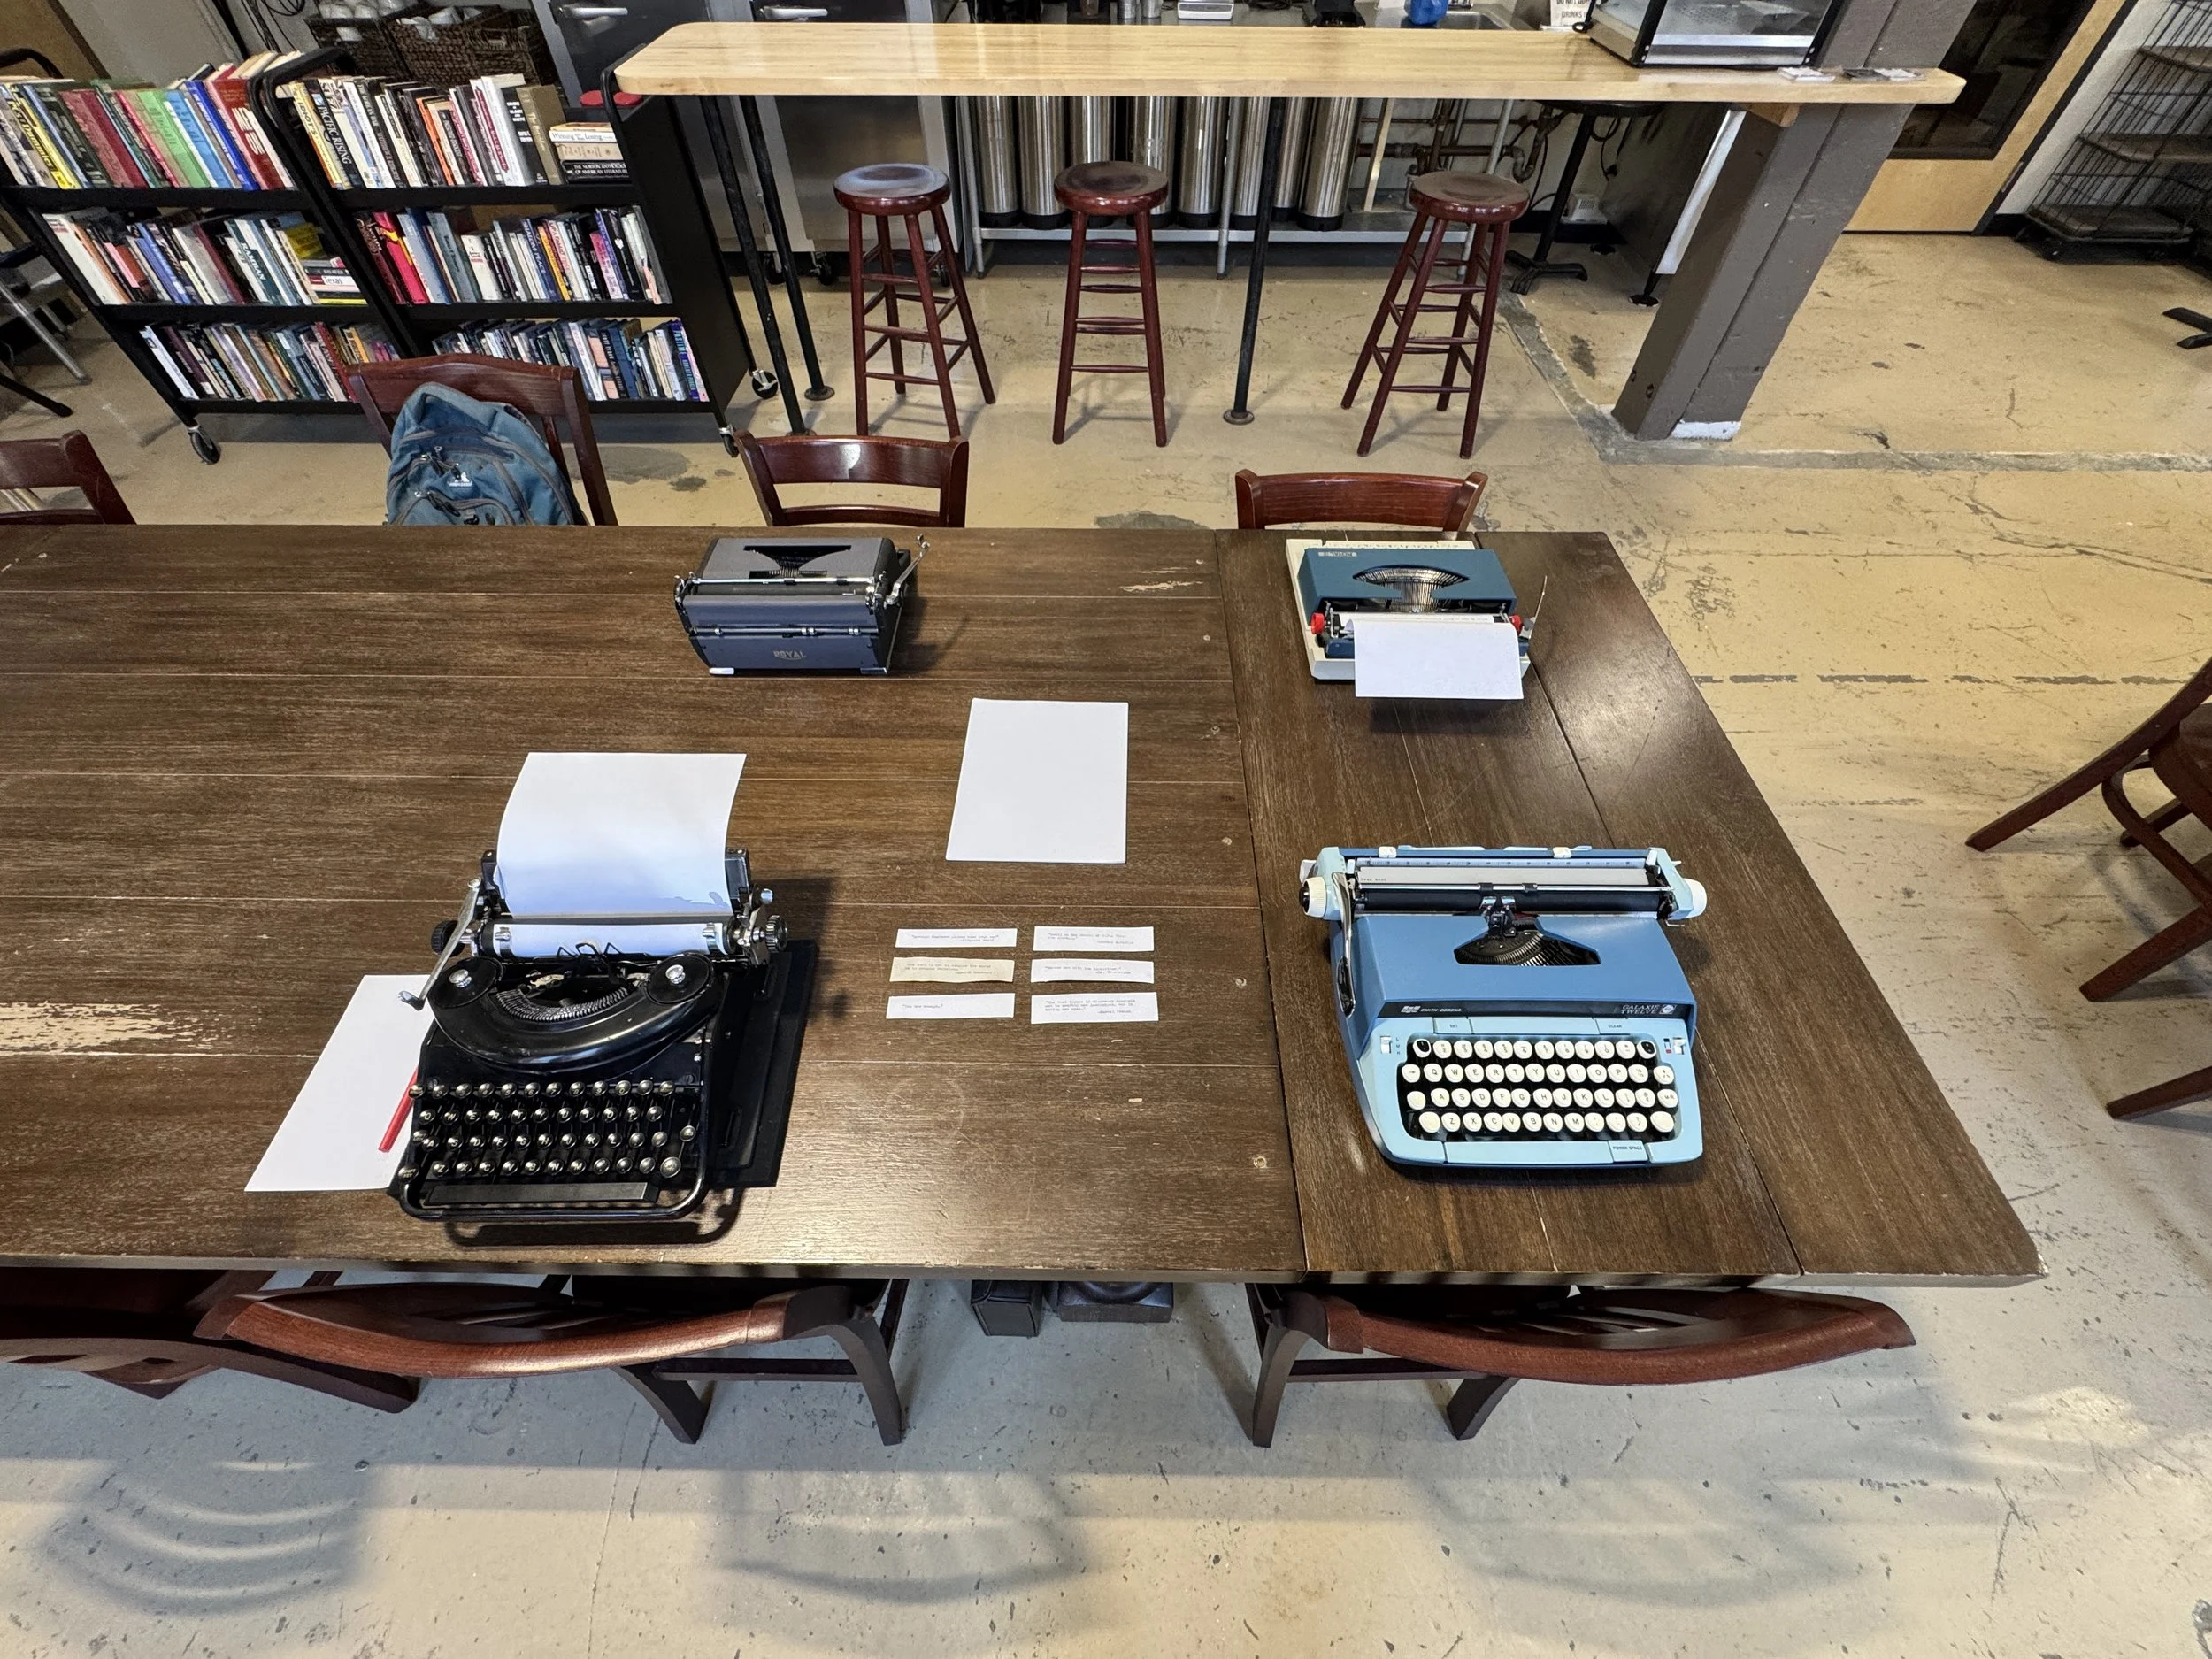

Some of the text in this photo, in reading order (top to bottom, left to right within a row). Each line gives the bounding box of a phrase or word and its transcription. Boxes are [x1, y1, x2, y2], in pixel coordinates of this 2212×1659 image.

[21, 123, 54, 167] Dummies
[317, 105, 352, 165] PACIFIC RISING
[552, 132, 575, 141] Winning
[522, 221, 546, 273] SHALOM PEACE
[324, 276, 343, 285] Texas
